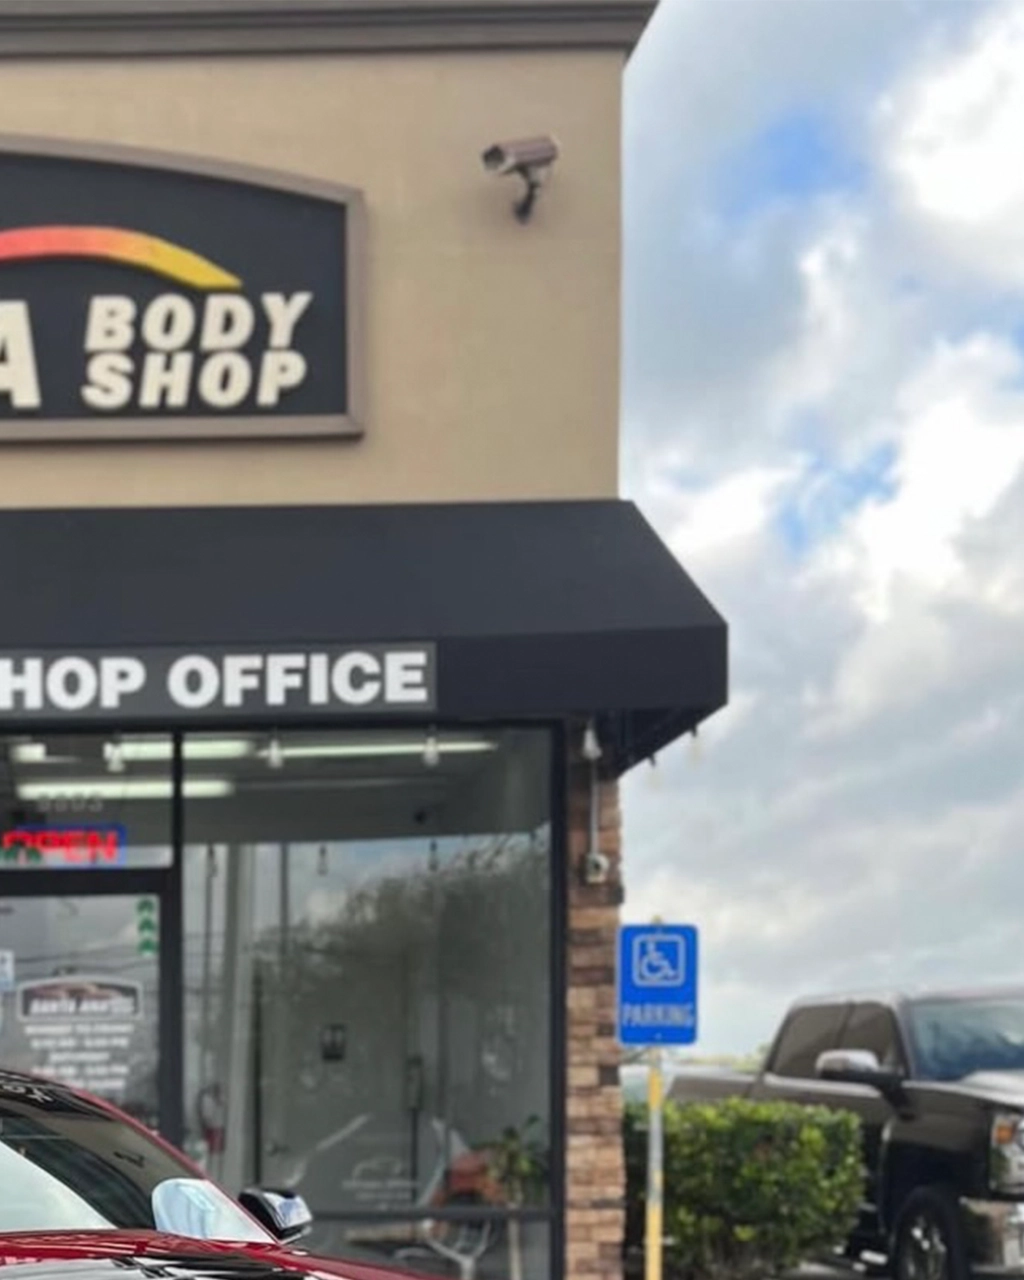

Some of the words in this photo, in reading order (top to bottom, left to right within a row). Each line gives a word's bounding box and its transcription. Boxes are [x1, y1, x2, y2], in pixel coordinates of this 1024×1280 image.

[84, 291, 312, 350] BODY
[80, 349, 308, 408] SHOP
[166, 651, 429, 709] OFFICE
[1, 830, 119, 863] OPEN
[622, 1003, 694, 1027] PARKING
